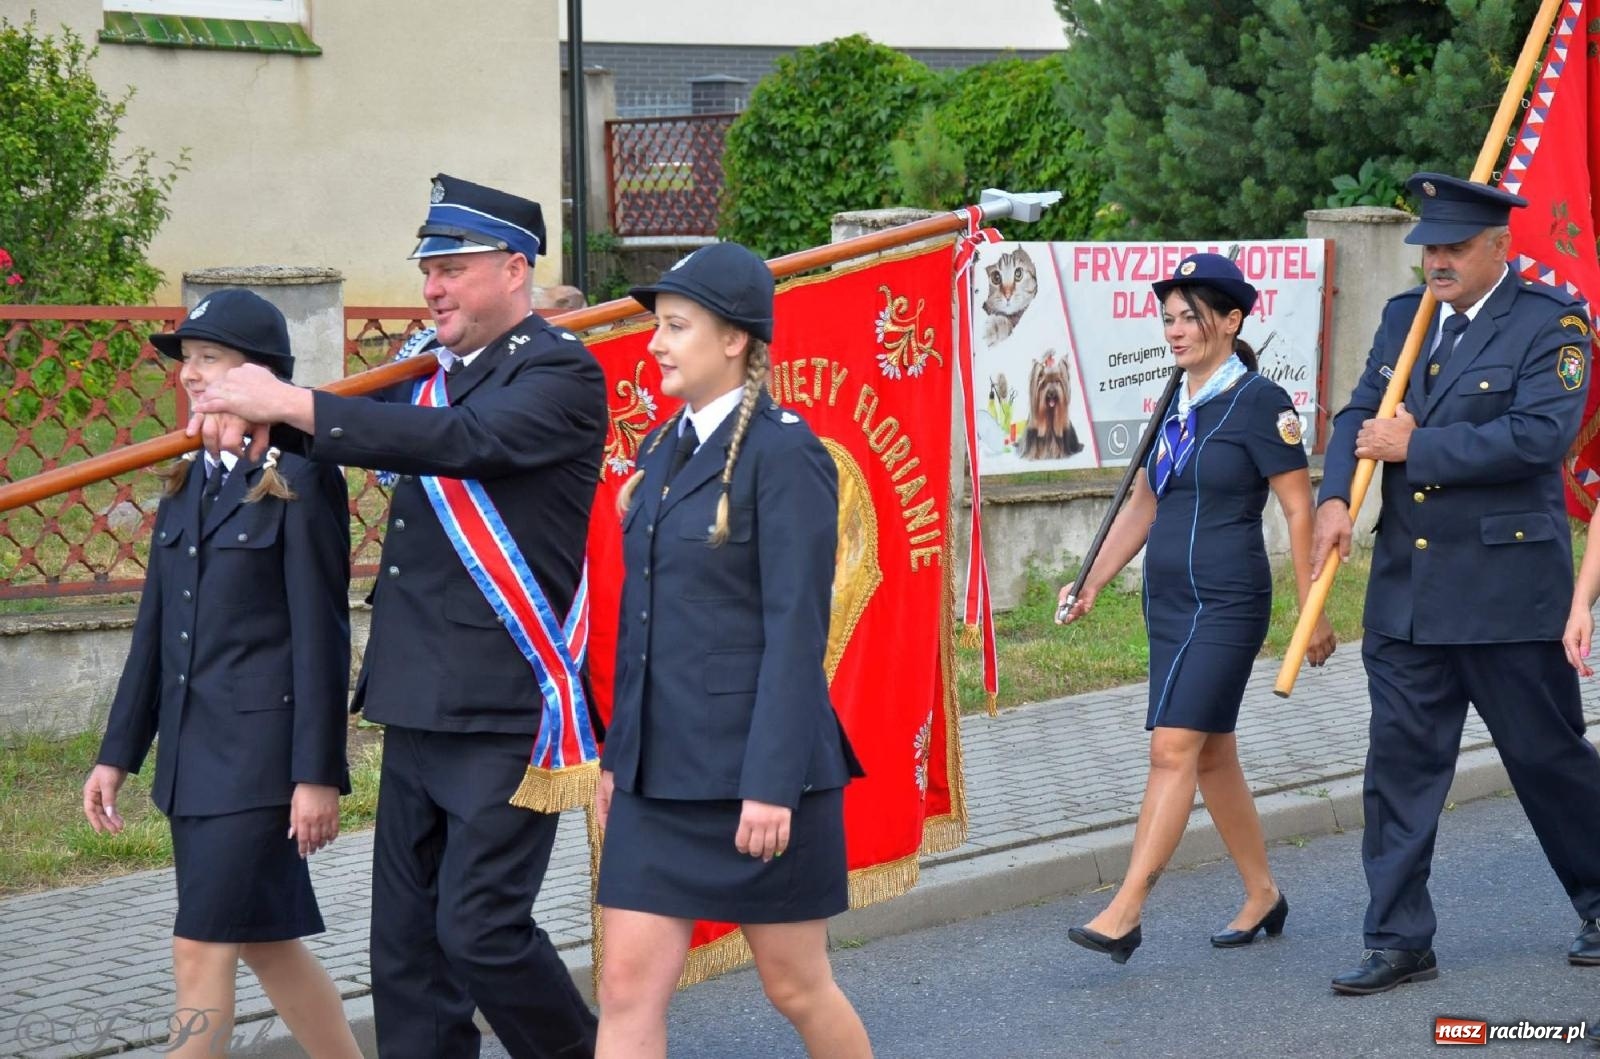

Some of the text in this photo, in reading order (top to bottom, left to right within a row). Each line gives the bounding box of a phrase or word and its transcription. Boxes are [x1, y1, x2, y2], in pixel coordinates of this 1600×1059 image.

[1074, 246, 1197, 282] FRYZJE
[1113, 291, 1158, 319] DLA
[1108, 346, 1167, 368] Oferujemy
[1099, 382, 1107, 392] z
[853, 384, 943, 573] FLORIANIE
